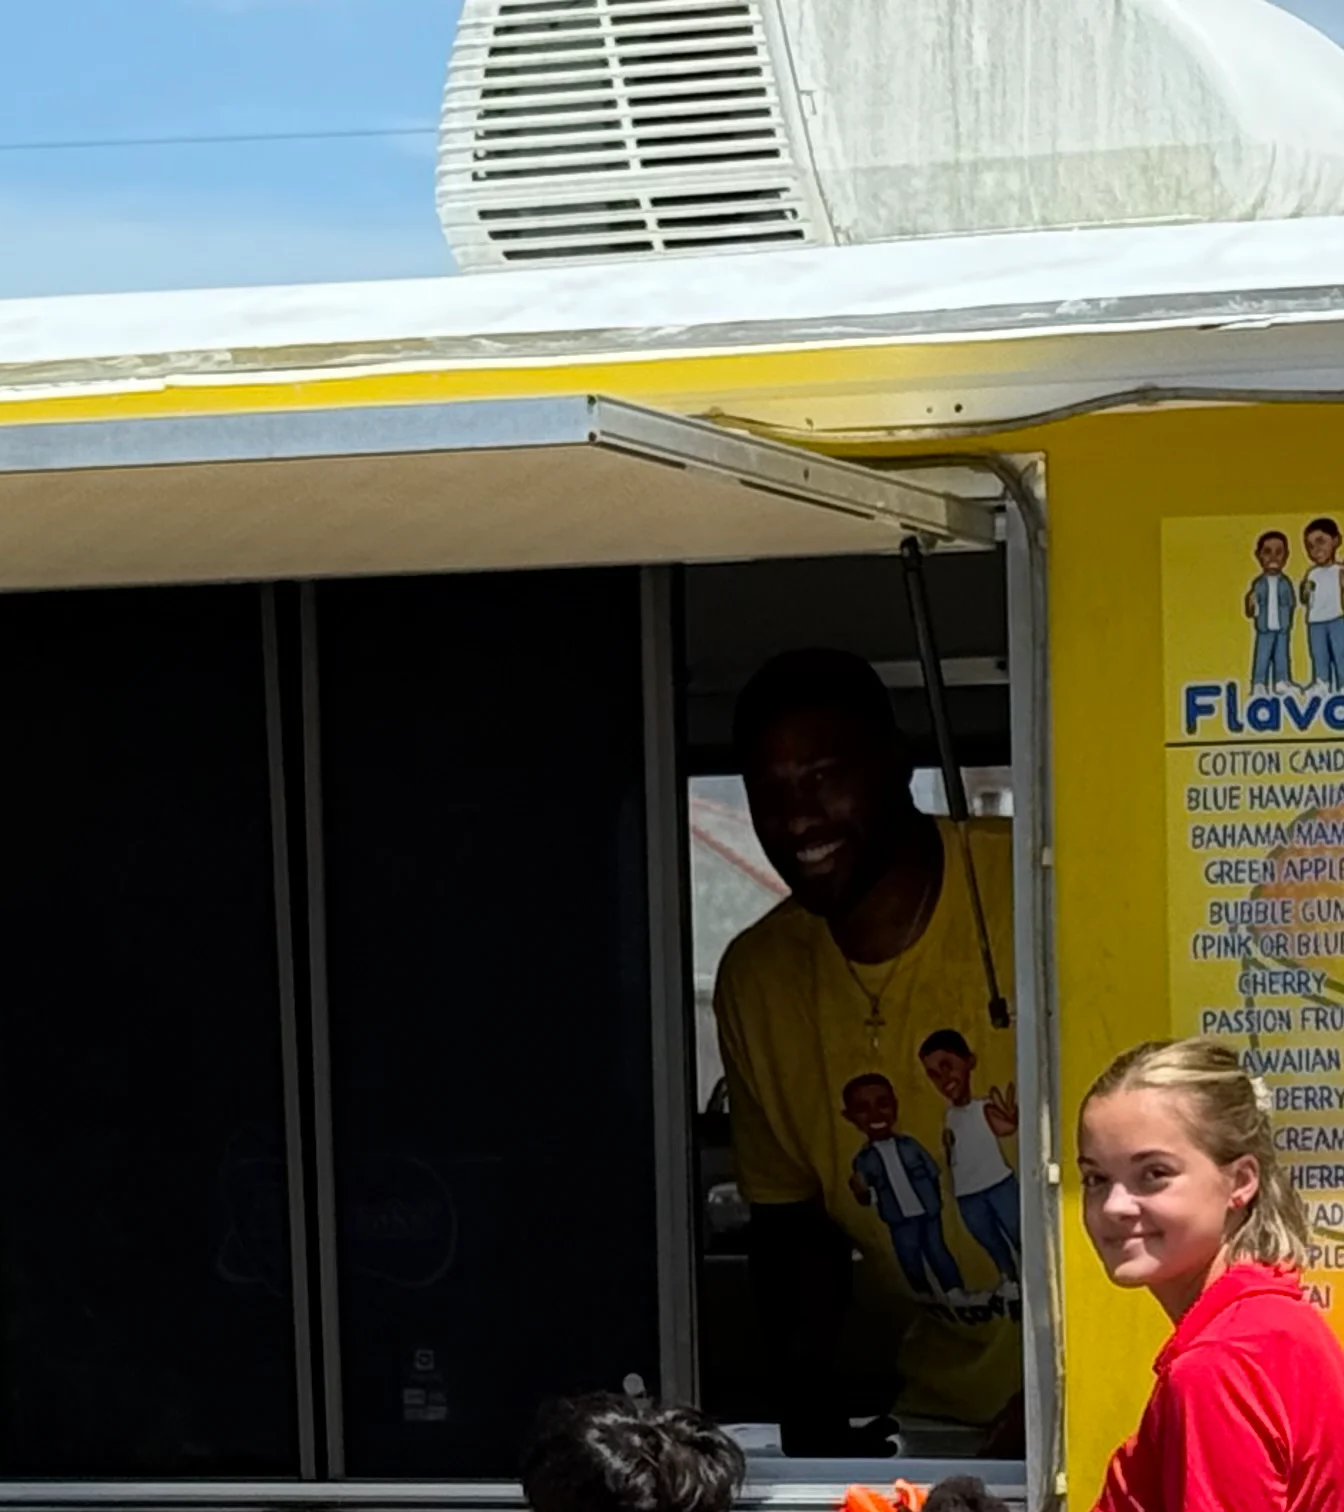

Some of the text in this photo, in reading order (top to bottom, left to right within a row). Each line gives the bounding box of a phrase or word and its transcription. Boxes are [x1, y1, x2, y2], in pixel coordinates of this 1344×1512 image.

[1198, 751, 1280, 776] COTTON
[1187, 786, 1241, 811] BLUE
[1192, 822, 1288, 848] BAHAMA
[1205, 860, 1275, 884] GREEN
[1209, 900, 1292, 925] BUBBLE
[1192, 934, 1252, 959] (PINK
[1261, 934, 1289, 957] OR
[1238, 972, 1326, 995] CHERRY
[1203, 1008, 1291, 1033] PASSION
